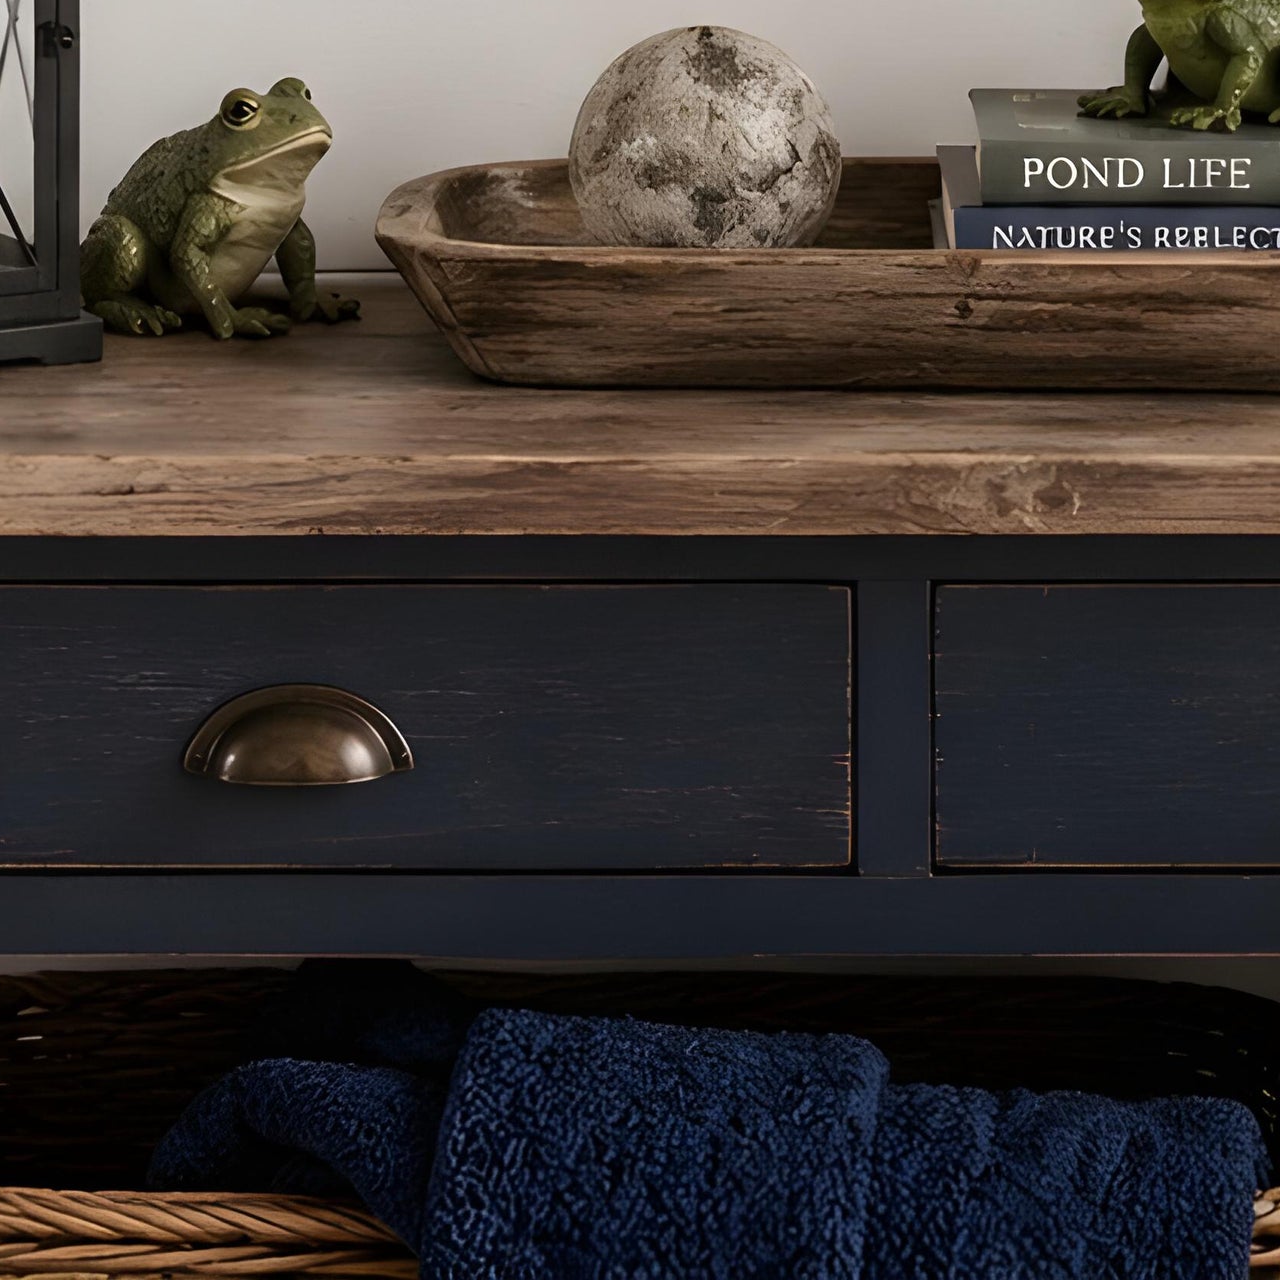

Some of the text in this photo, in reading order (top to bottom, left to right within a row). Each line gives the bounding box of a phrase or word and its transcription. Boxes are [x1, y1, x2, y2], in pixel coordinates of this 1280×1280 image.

[1023, 156, 1251, 189] POND LIFE
[993, 220, 1142, 249] NATURE'S
